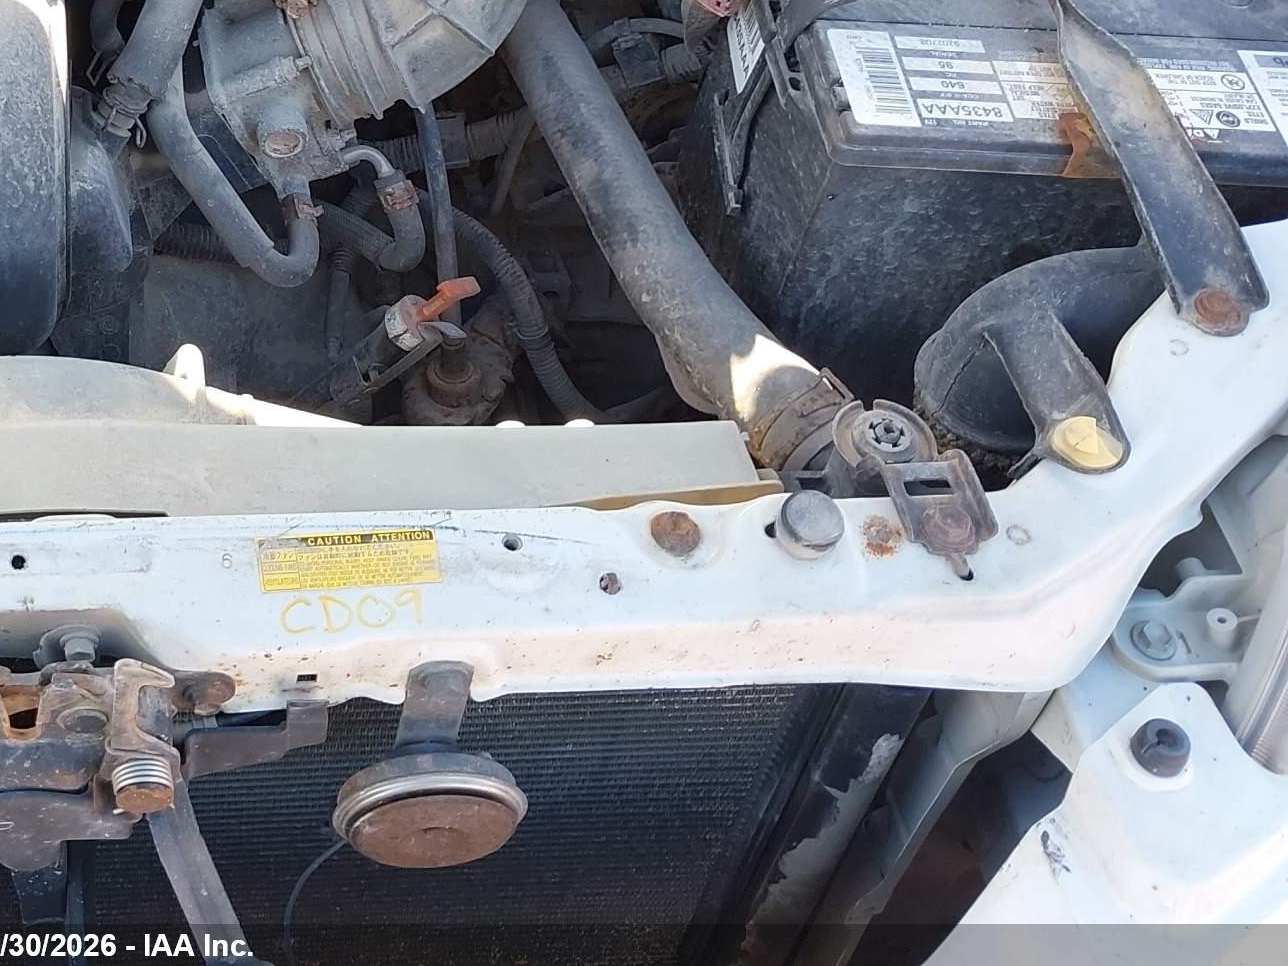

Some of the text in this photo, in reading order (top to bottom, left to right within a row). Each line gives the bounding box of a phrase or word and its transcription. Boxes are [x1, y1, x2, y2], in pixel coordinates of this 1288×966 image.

[938, 61, 954, 70] 95
[940, 80, 966, 90] 640
[921, 103, 1003, 119] 8435AAA
[308, 535, 362, 546] CAUTION
[371, 531, 431, 542] ATTENTION
[221, 553, 233, 569] 6
